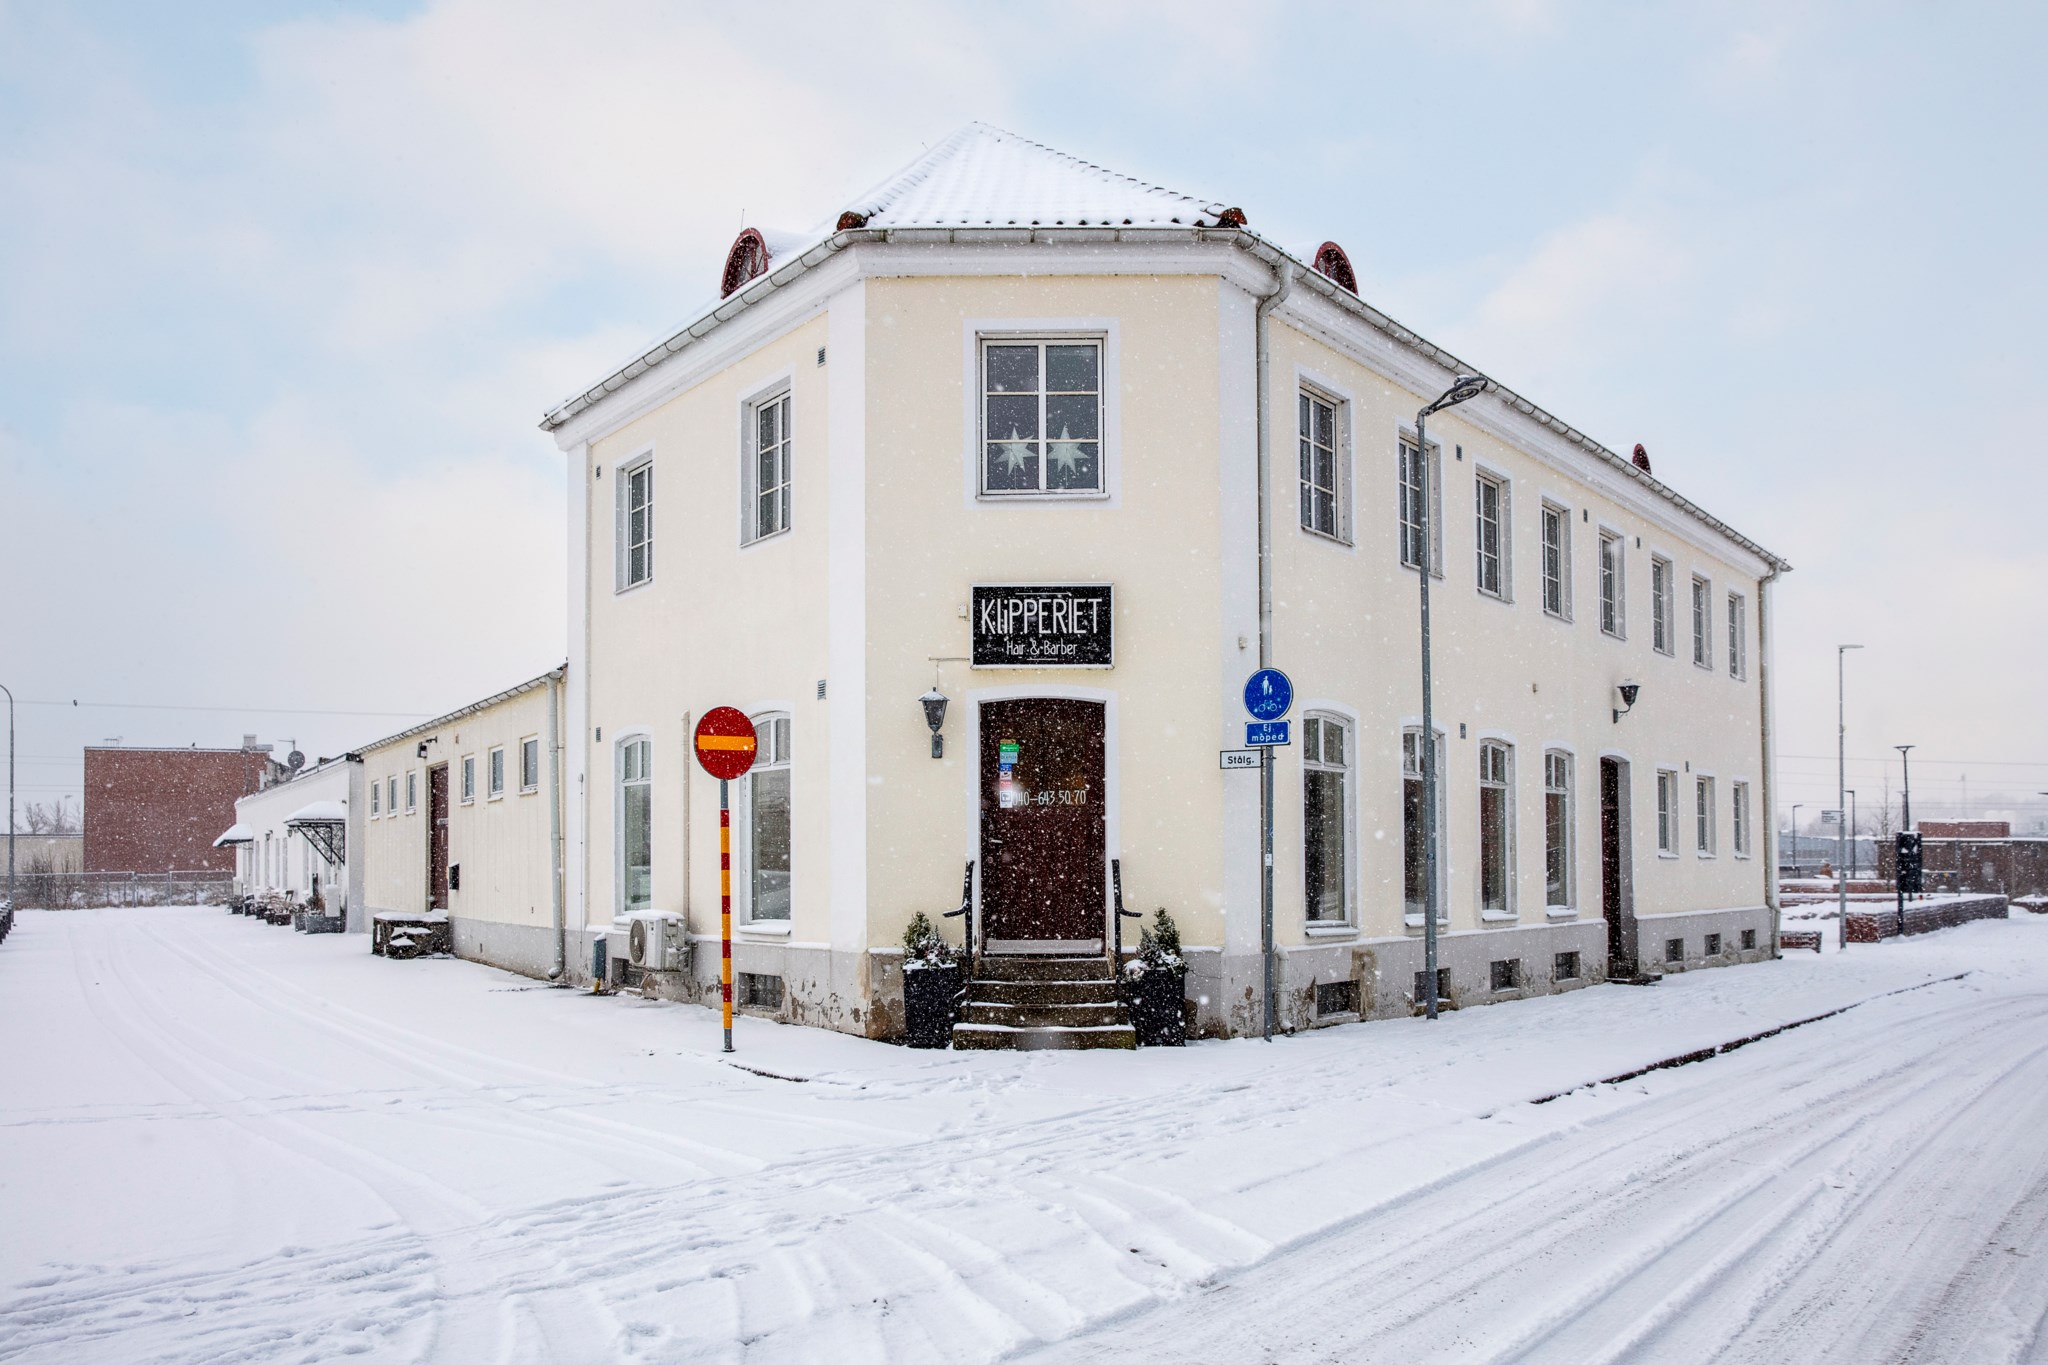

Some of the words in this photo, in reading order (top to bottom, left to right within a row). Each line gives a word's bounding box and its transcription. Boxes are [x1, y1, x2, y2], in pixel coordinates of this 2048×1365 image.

[1006, 640, 1025, 655] Hair
[1030, 639, 1040, 655] &
[1043, 637, 1077, 655] Barber
[1263, 724, 1271, 733] Ej
[1251, 733, 1284, 743] moped
[1227, 756, 1255, 765] Stålg.
